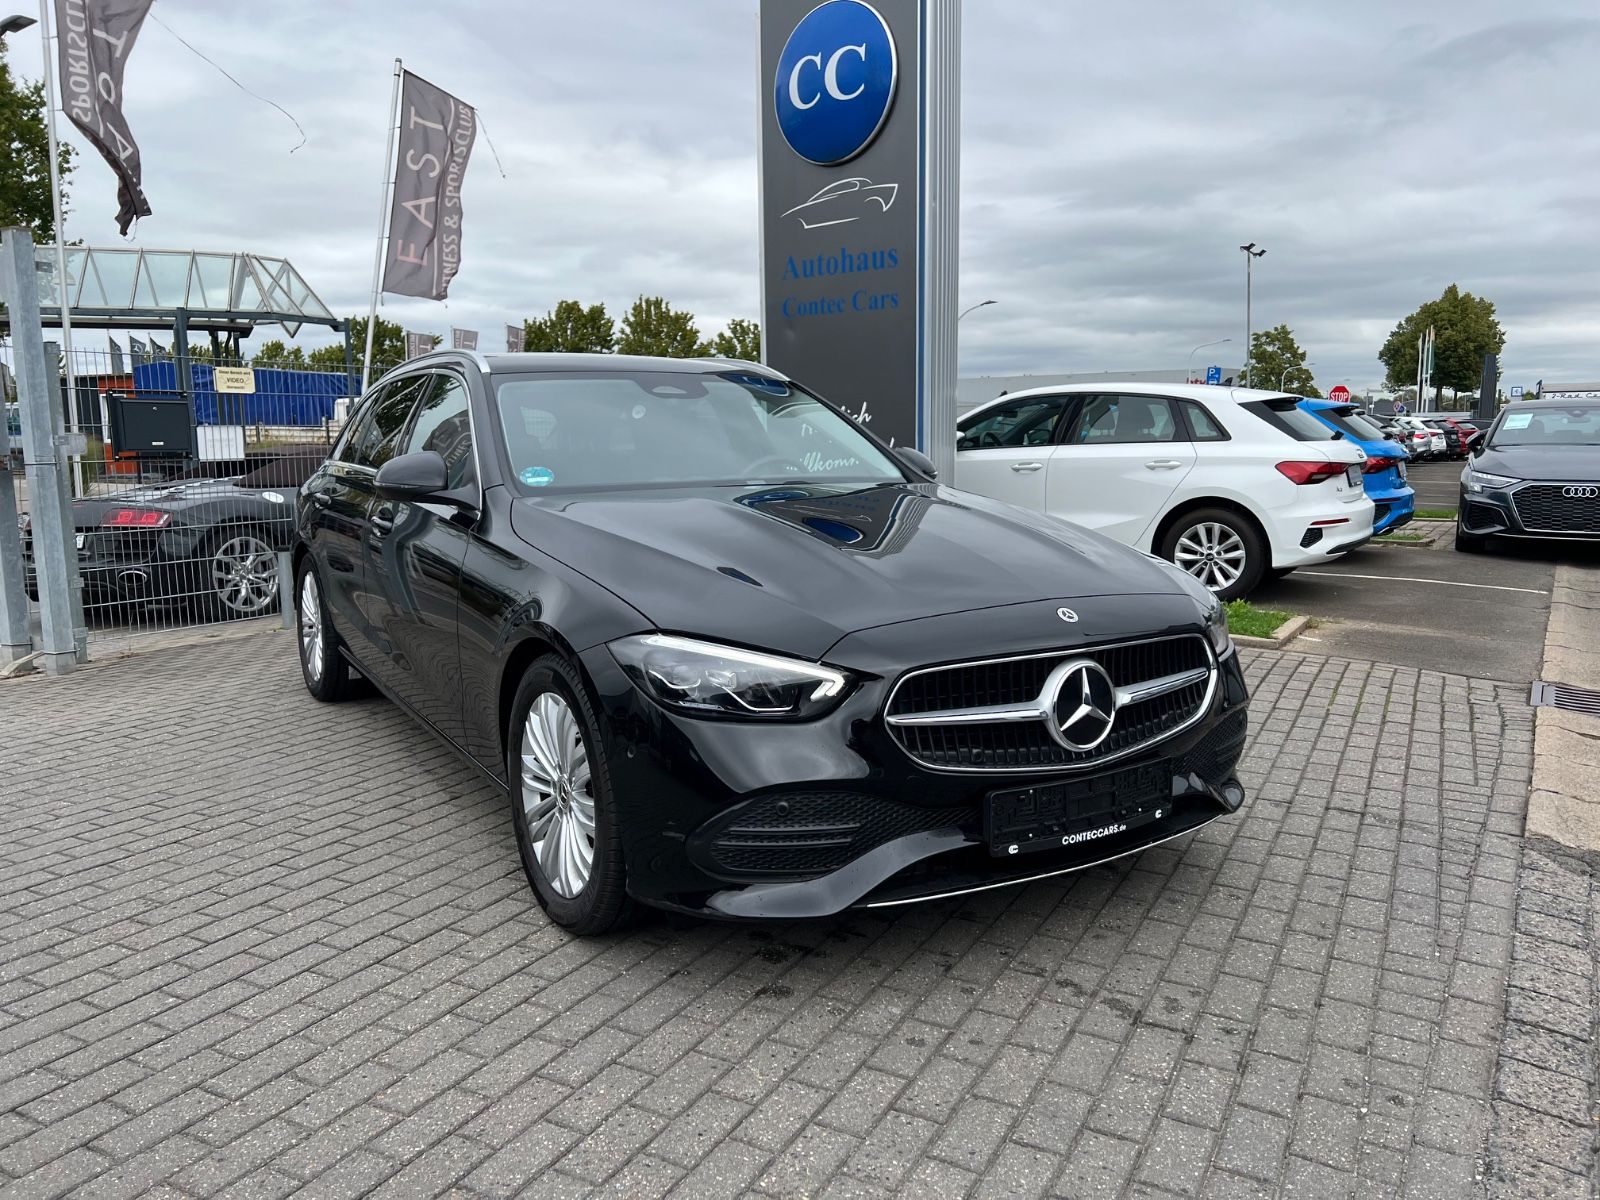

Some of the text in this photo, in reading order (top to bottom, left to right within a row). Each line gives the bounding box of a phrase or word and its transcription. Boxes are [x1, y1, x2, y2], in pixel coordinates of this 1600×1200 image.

[788, 42, 866, 110] CC
[443, 214, 459, 229] &
[783, 247, 899, 280] Autohaus
[782, 288, 899, 318] Contec Cars
[1330, 391, 1349, 402] STOP
[1061, 824, 1127, 845] CONTECCARS.de
